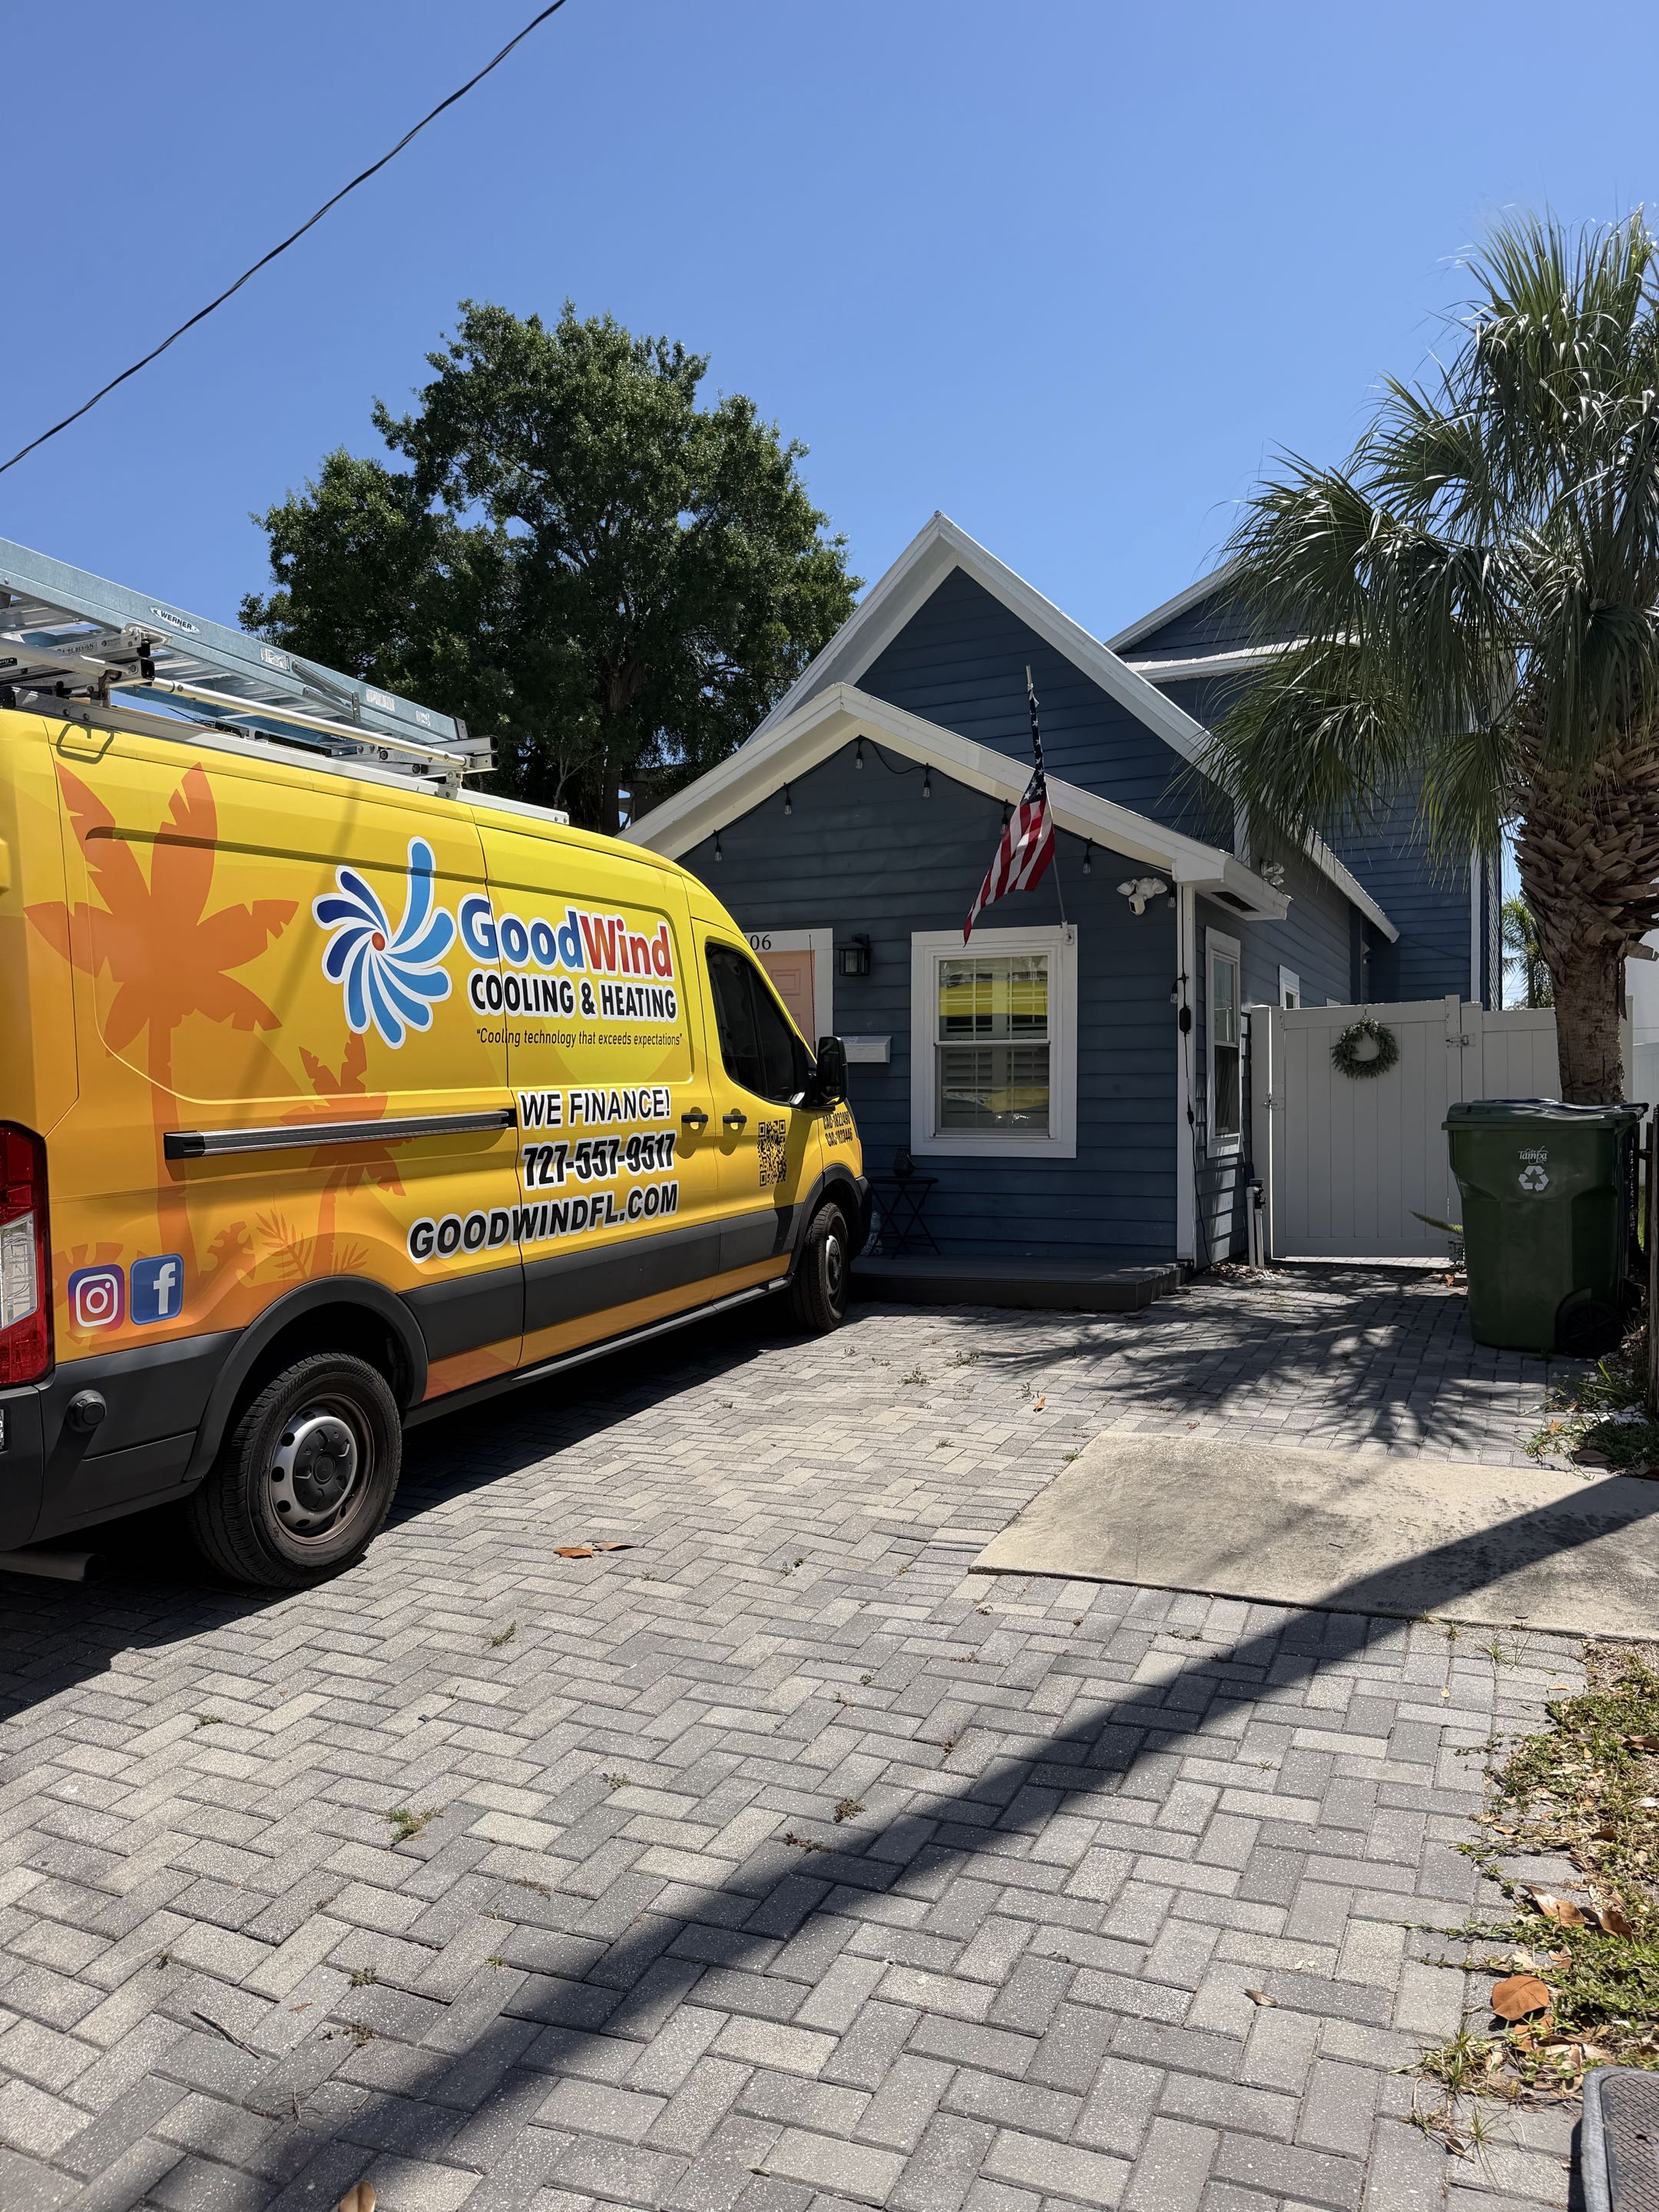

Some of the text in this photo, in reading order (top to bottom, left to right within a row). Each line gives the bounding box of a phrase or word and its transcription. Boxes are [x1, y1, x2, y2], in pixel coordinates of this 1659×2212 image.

[161, 611, 192, 630] WERNER
[460, 897, 674, 978] GoodWind
[744, 934, 772, 951] 06
[471, 973, 677, 1018] COOLING & HEATING
[476, 1028, 683, 1048] "Cooling technology that exceeds expectations"
[520, 1088, 671, 1127] WE FINANCE!
[524, 1132, 676, 1187] 727-557-9517
[1518, 1145, 1548, 1164] Tampa
[409, 1184, 678, 1260] GOODWINDFL.COM
